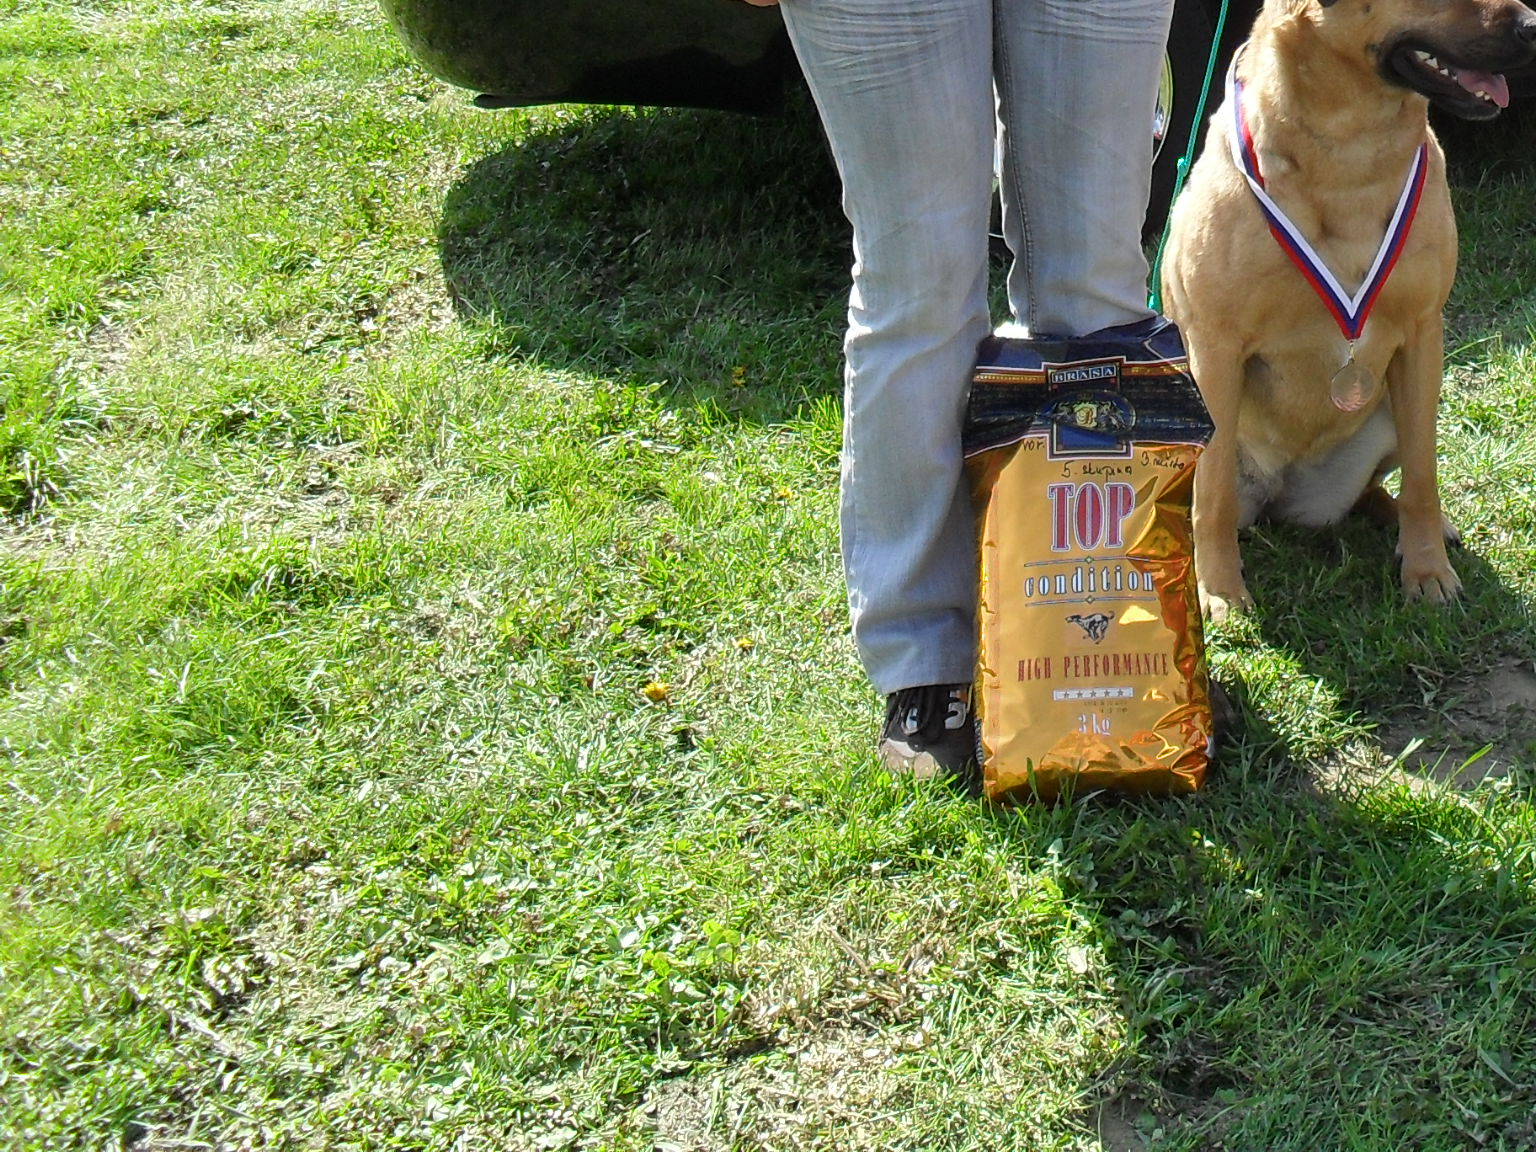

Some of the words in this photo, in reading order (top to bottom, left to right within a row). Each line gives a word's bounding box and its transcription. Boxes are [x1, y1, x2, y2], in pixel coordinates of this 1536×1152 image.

[1051, 364, 1117, 384] BRASA
[1047, 482, 1136, 553] TOP
[1024, 566, 1156, 599] condition
[1017, 656, 1052, 682] HIGH
[1063, 652, 1170, 679] PERFORMANCE
[1077, 714, 1088, 734] 3
[1091, 712, 1111, 737] kg
